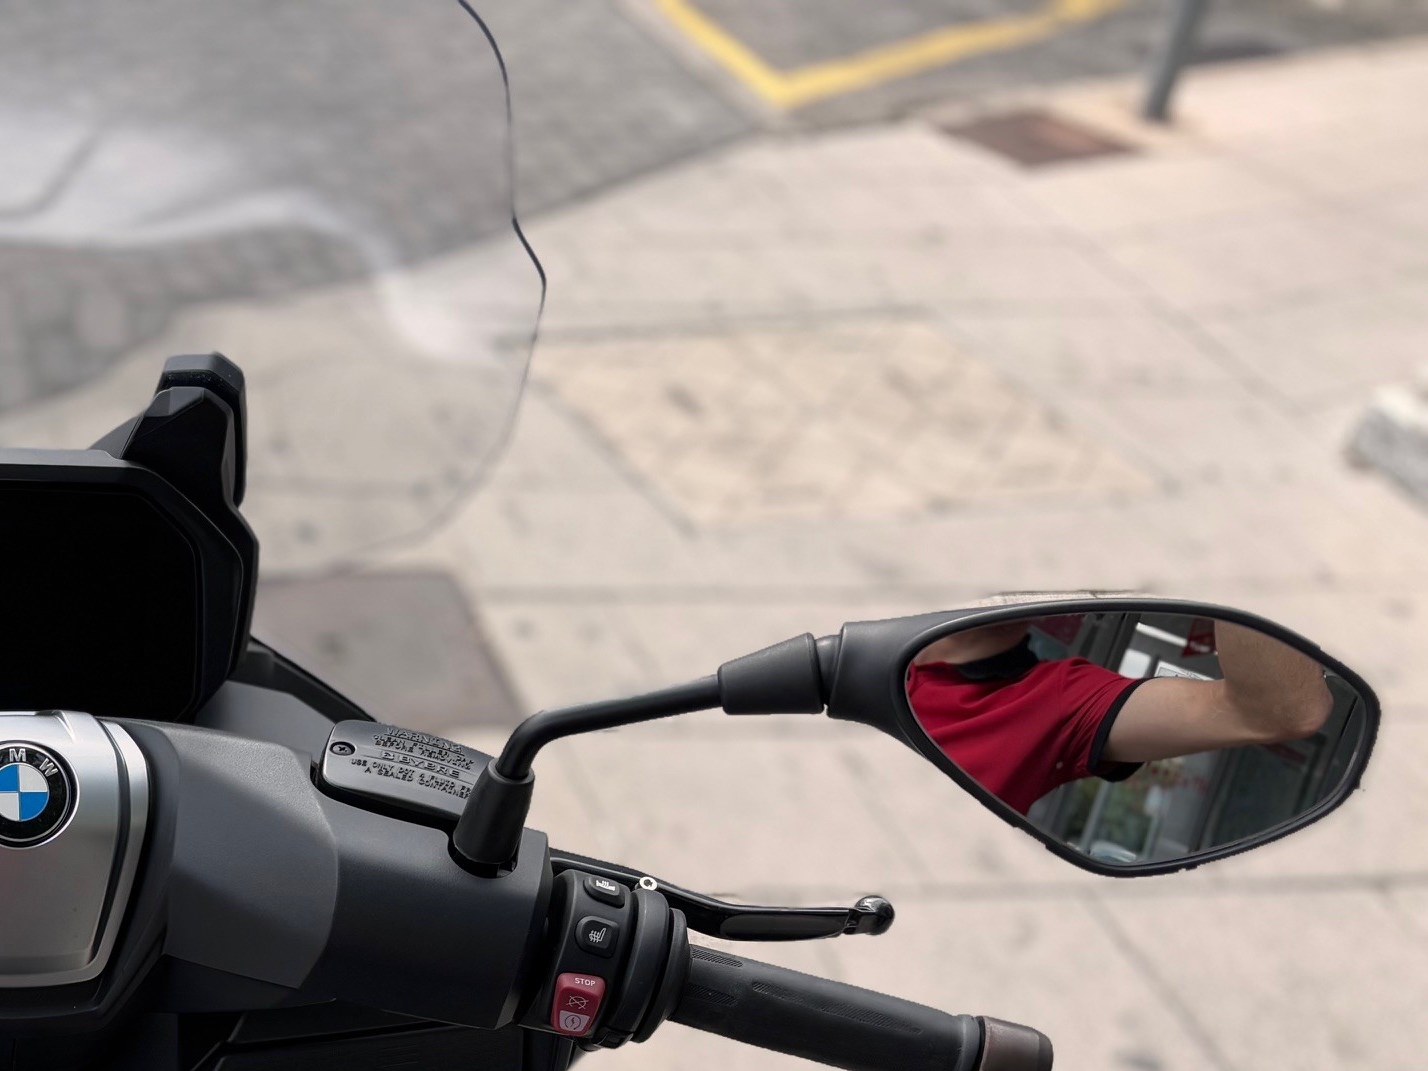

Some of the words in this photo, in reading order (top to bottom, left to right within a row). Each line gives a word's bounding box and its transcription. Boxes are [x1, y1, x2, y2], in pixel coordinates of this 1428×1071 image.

[387, 727, 463, 754] WARNING
[351, 759, 367, 767] USE
[373, 762, 394, 772] ONLY
[378, 770, 414, 782] SEALED
[574, 977, 596, 986] STOP
